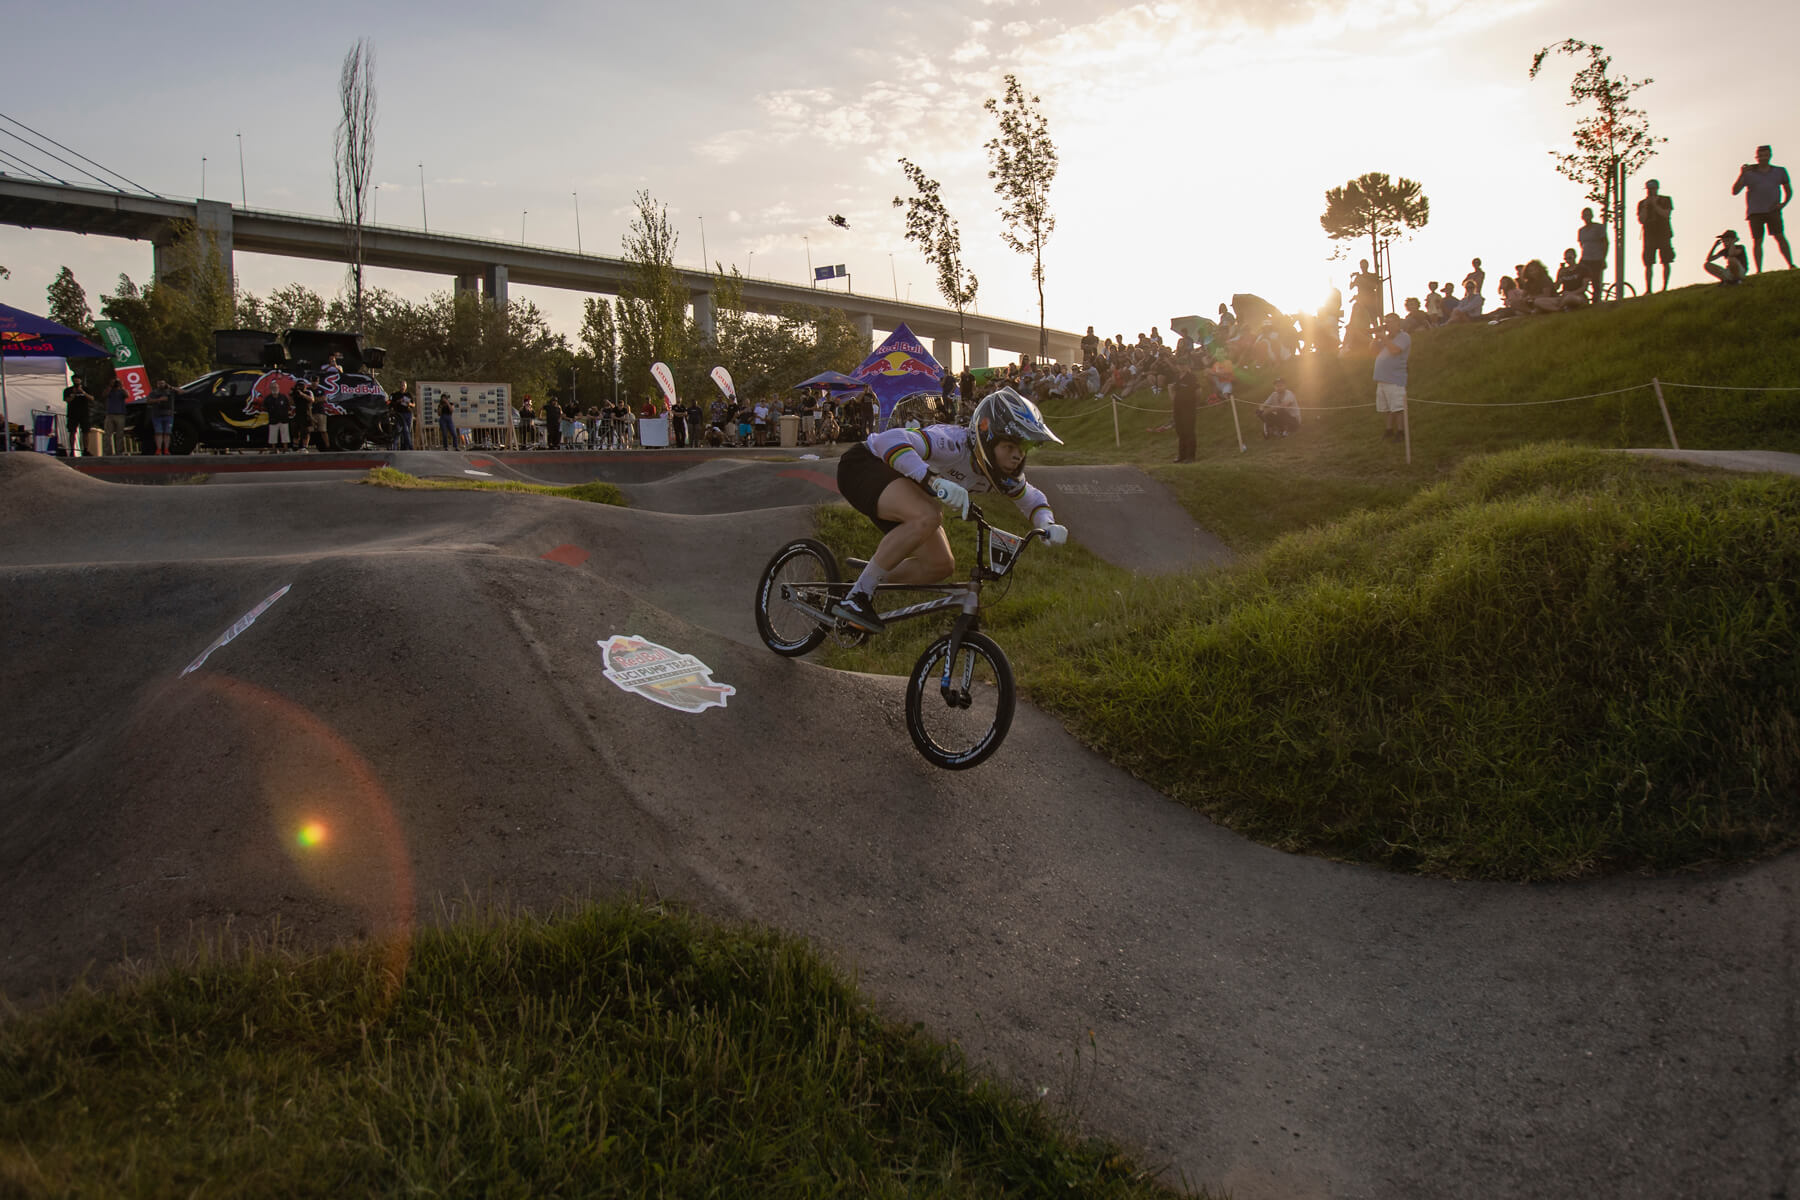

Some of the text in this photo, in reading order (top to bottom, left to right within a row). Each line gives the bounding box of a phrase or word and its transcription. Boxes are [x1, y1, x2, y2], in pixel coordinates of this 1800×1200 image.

[877, 342, 923, 354] Red Bull
[340, 384, 381, 395] Red Bull
[950, 470, 967, 481] UCI
[615, 648, 670, 668] Red Bull
[619, 670, 642, 681] UCI
[641, 665, 667, 677] PUMP
[667, 658, 697, 670] TRACK
